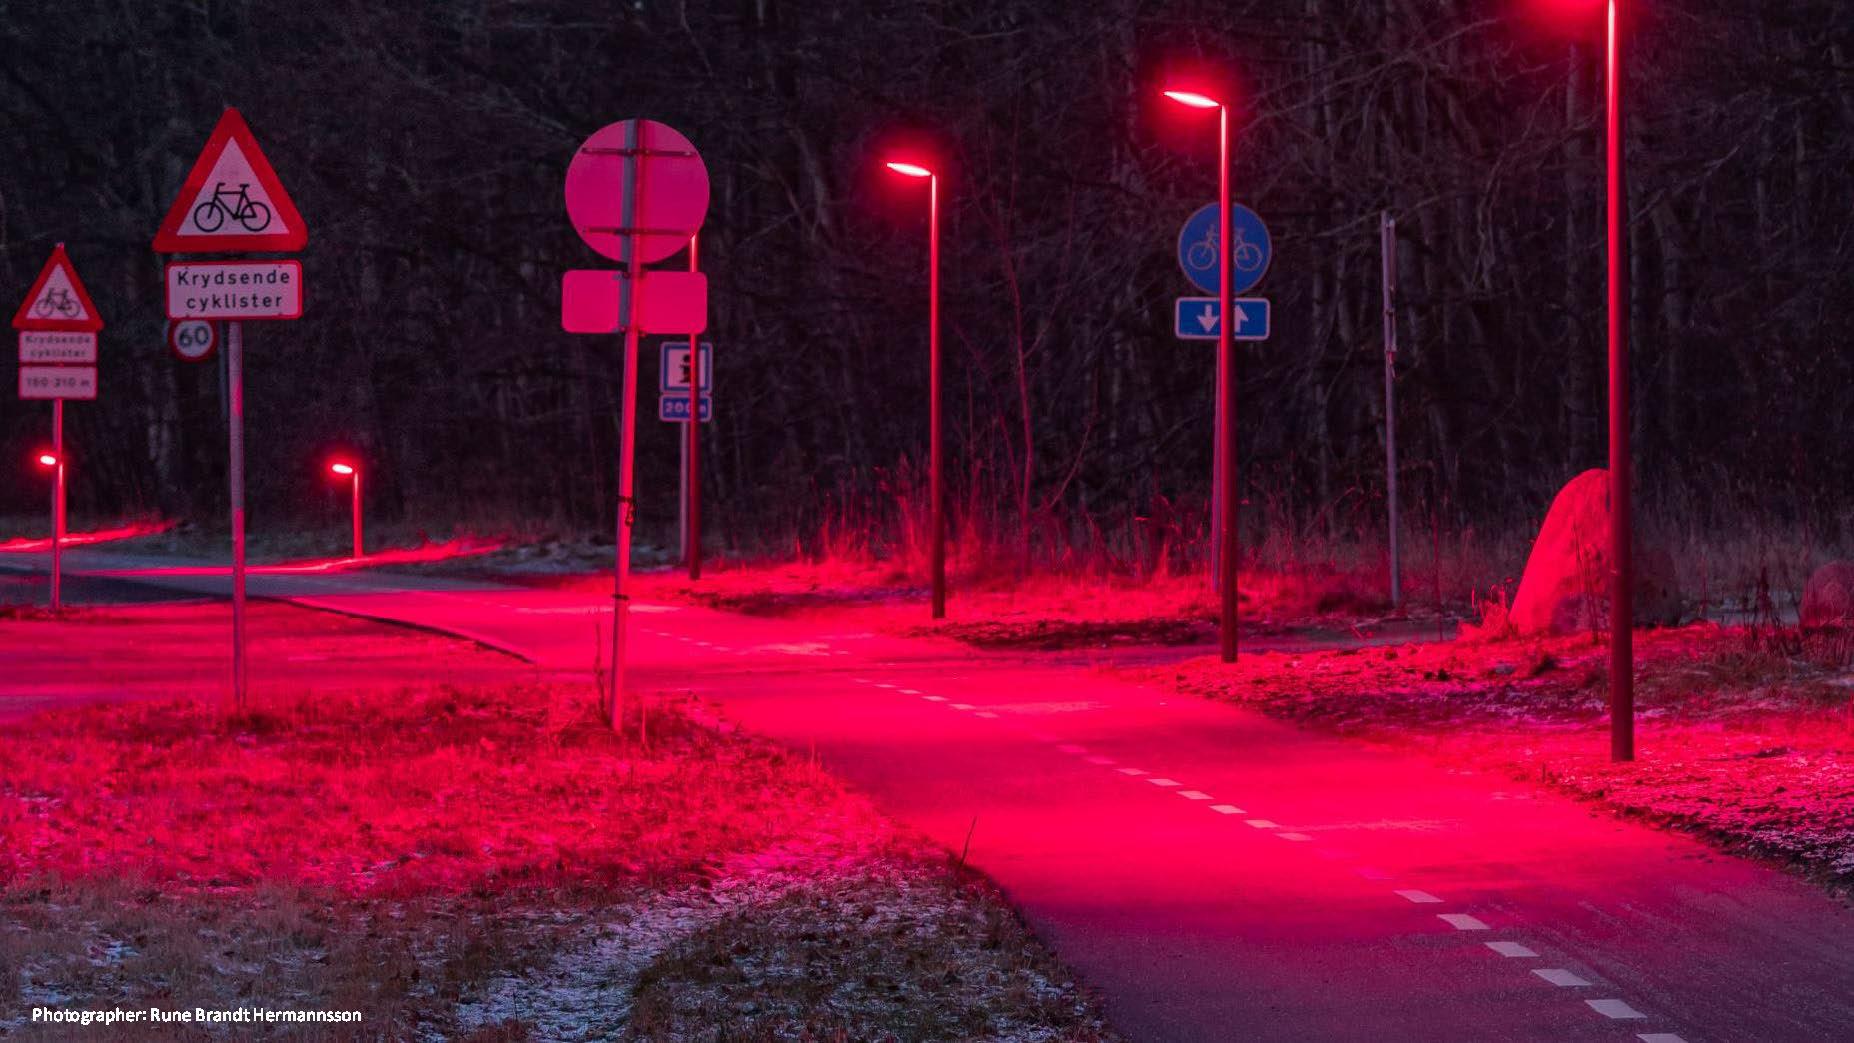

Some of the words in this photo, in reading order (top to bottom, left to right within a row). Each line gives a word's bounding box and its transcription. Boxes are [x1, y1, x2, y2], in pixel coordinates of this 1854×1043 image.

[178, 269, 290, 288] Krydsende
[186, 293, 282, 311] cyklister
[178, 326, 209, 348] 60
